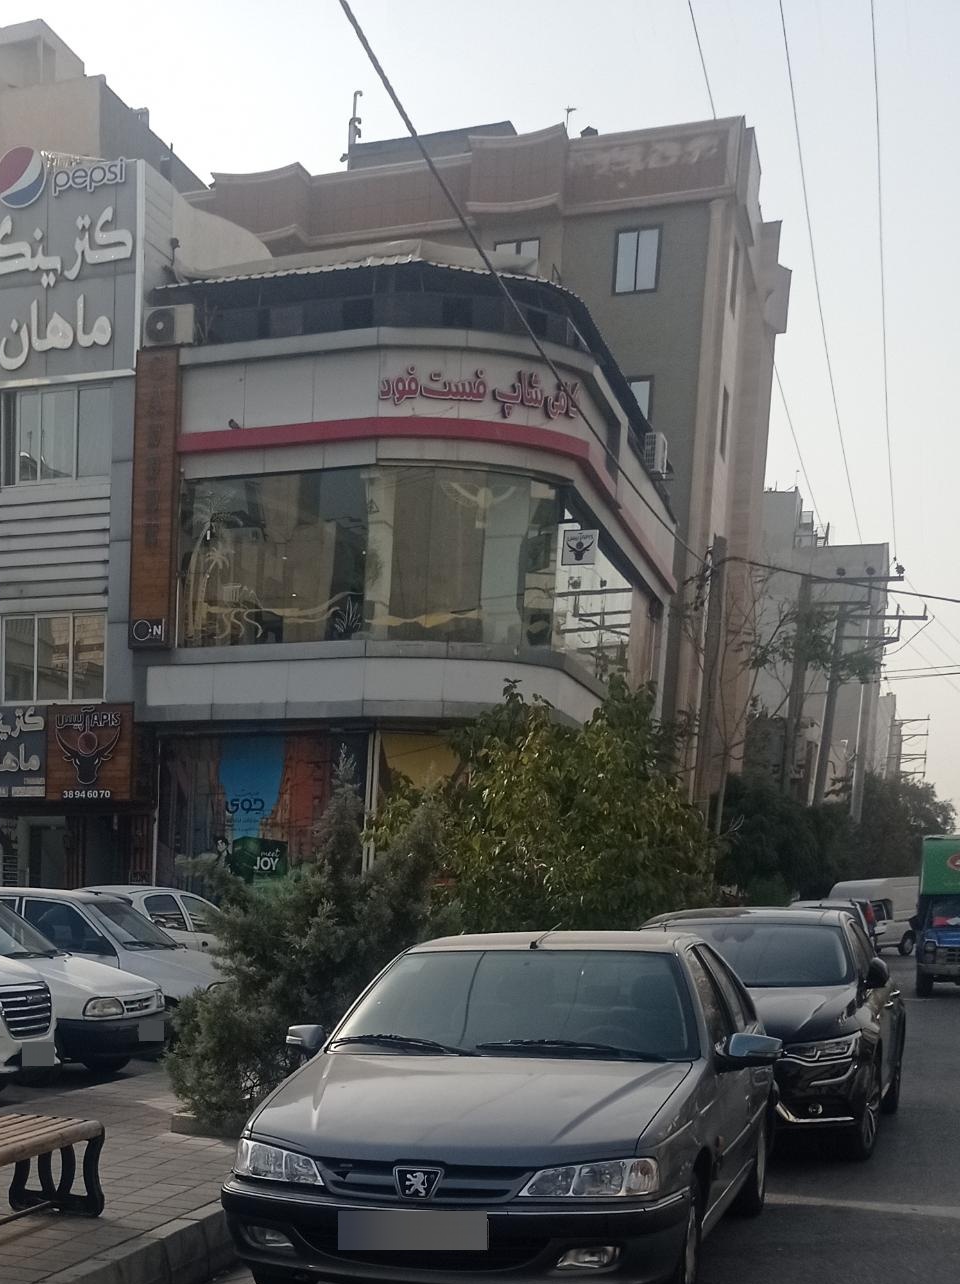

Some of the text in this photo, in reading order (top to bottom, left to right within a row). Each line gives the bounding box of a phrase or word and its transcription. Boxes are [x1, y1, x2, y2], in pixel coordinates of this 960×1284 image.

[52, 157, 126, 196] pepsi
[379, 366, 420, 405] فود
[421, 369, 488, 402] فست
[493, 370, 544, 418] شاپ
[91, 711, 121, 727] APIS
[253, 857, 279, 871] JOY
